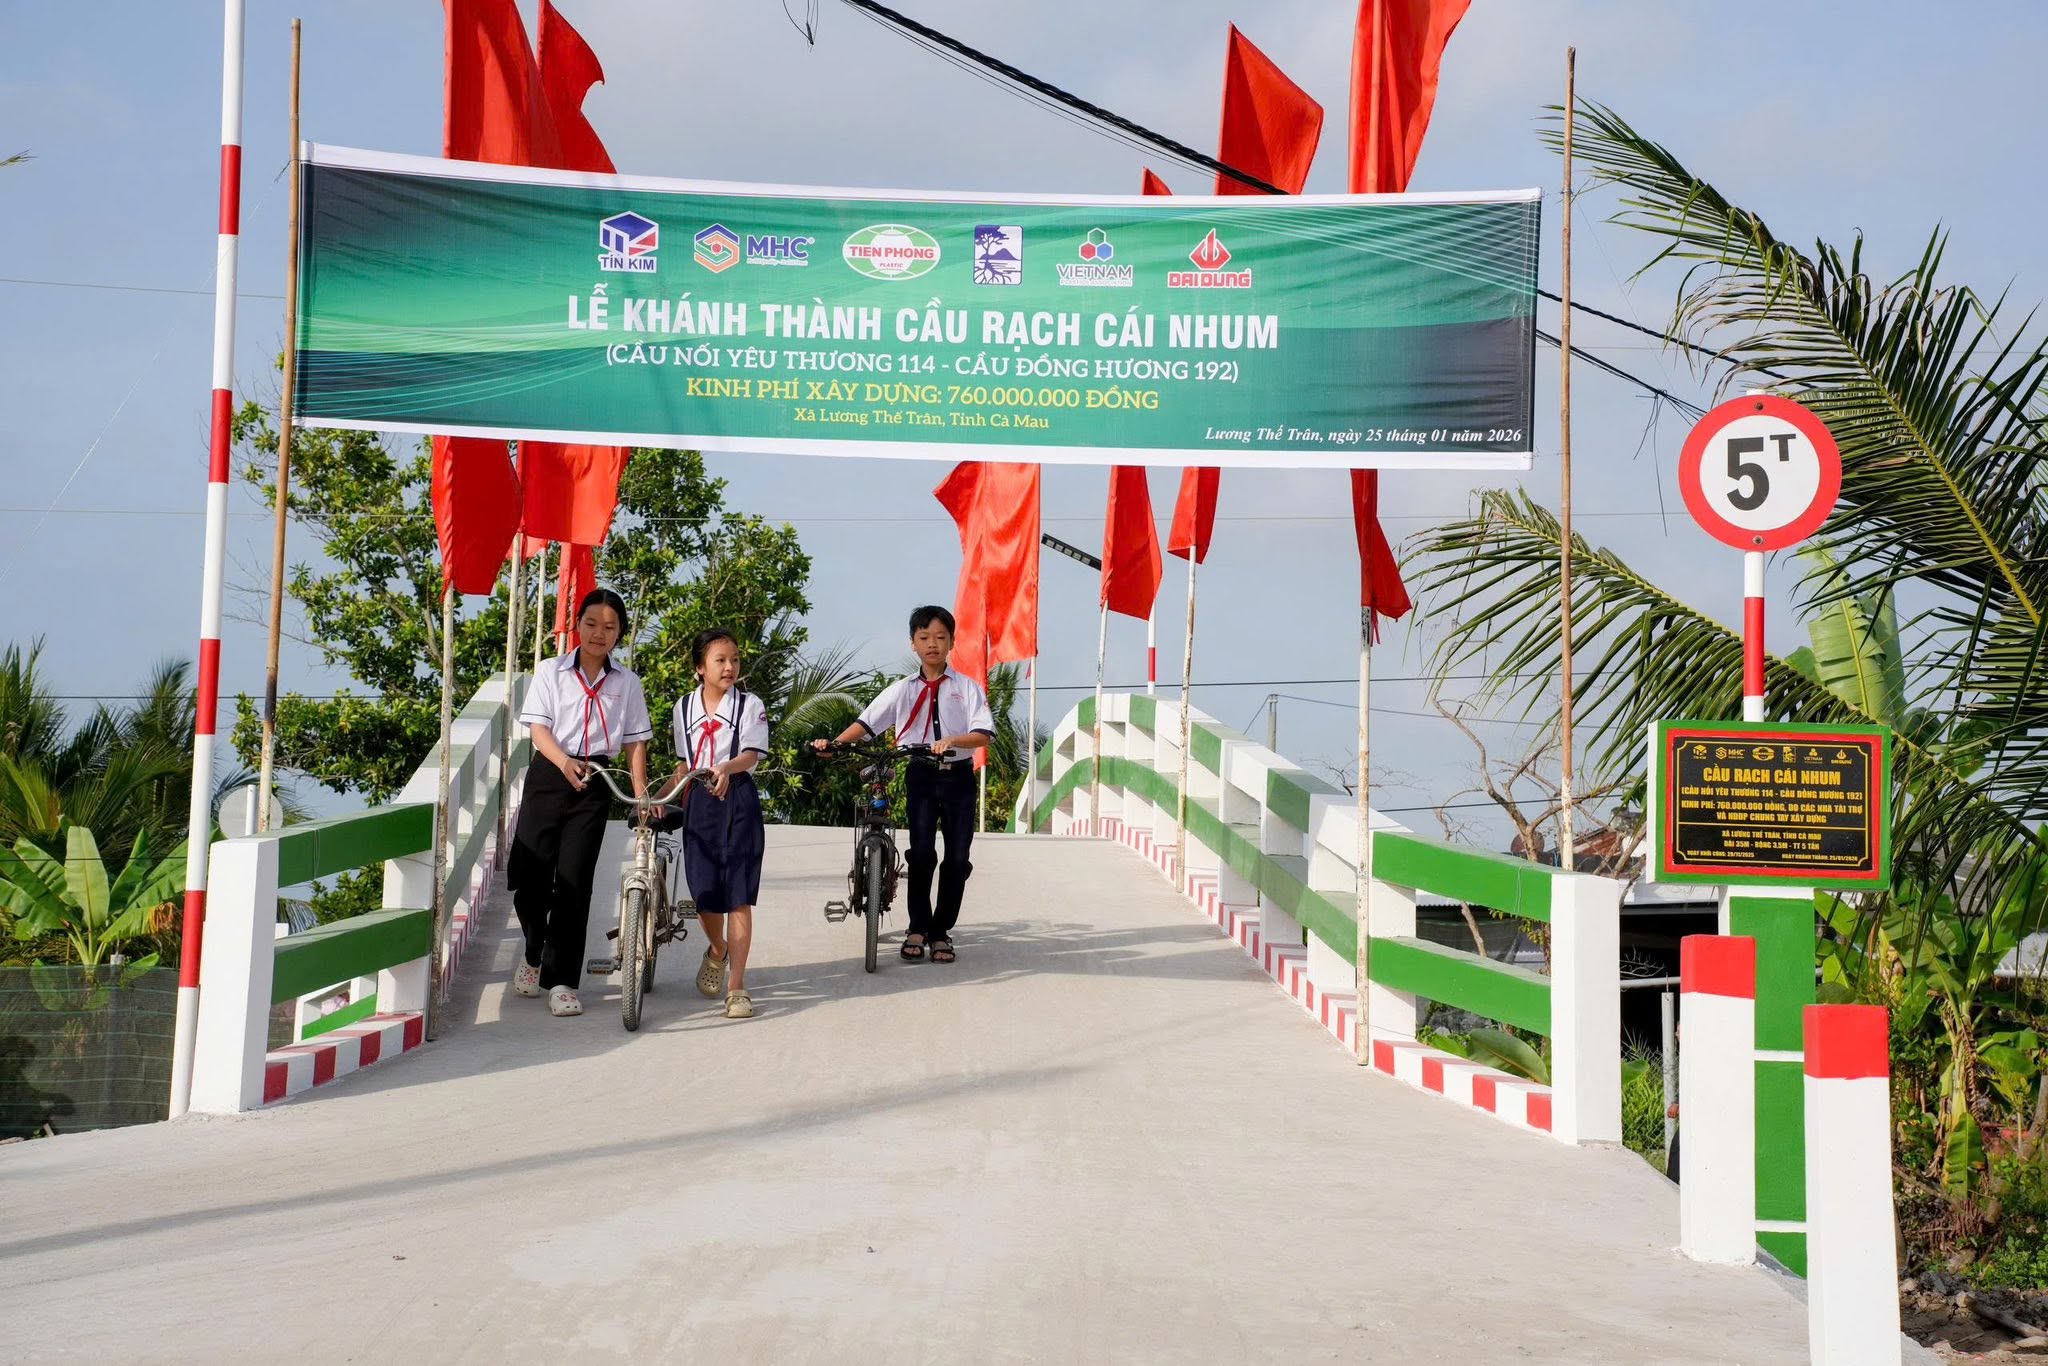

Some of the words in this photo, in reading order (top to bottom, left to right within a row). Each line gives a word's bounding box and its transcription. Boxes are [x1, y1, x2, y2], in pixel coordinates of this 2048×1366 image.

[748, 235, 808, 259] MHC
[850, 246, 882, 257] TIEN
[884, 248, 935, 259] PHONG
[600, 254, 624, 269] TÍN
[629, 258, 654, 270] KIM
[1057, 264, 1133, 279] VIETNAM
[568, 283, 609, 330] LỄ
[623, 292, 747, 336] KHÁNH
[760, 297, 881, 341] THÀNH
[895, 297, 968, 344] CẦU
[982, 311, 1080, 352] RẠCH
[1094, 305, 1154, 348] CÁI
[1169, 315, 1279, 349] NHUM
[606, 340, 667, 366] (CẦU
[674, 343, 719, 368] NỐI
[727, 347, 776, 369] YÊU
[783, 350, 892, 373] THƯƠNG
[900, 354, 935, 373] 114
[956, 352, 1010, 376] CẦU
[1016, 354, 1089, 379] ĐỒNG
[1094, 358, 1189, 380] HƯƠNG
[1195, 361, 1239, 384] 192)
[686, 377, 752, 398] KINH
[757, 377, 799, 400] PHÍ
[806, 380, 858, 401] XÂY
[864, 383, 942, 406] DỰNG:
[948, 386, 1080, 408] 760.000.000
[1085, 385, 1159, 409] ĐỒNG
[794, 408, 816, 421] Xã
[820, 409, 869, 426] Lương
[873, 410, 902, 424] Thế
[906, 411, 946, 427] Trân,
[990, 413, 1010, 427] Cà
[1013, 415, 1049, 428] Mau
[1205, 427, 1251, 443] Lương
[1257, 424, 1284, 440] Thế
[1287, 429, 1324, 443] Trân,
[1328, 430, 1362, 444] ngày
[1365, 429, 1383, 442] 25
[1386, 429, 1426, 445] tháng
[1431, 430, 1446, 442] 01
[1452, 430, 1483, 442] năm
[1487, 430, 1522, 442] 2026
[1703, 763, 1730, 782] CẦU
[1734, 768, 1770, 785] RẠCH
[1774, 768, 1797, 785] CÁI
[1801, 770, 1841, 785] NHUM
[1762, 789, 1774, 797] 114
[1681, 800, 1699, 809] KINH
[1717, 801, 1763, 811] 760.000.000
[1801, 803, 1816, 812] CÁC
[1834, 804, 1846, 813] TÀI
[1716, 811, 1727, 820] VÀ
[1750, 813, 1775, 821] CHUNG
[1776, 813, 1789, 822] TAY
[1790, 813, 1805, 823] XÂY
[1802, 842, 1807, 850] 5
